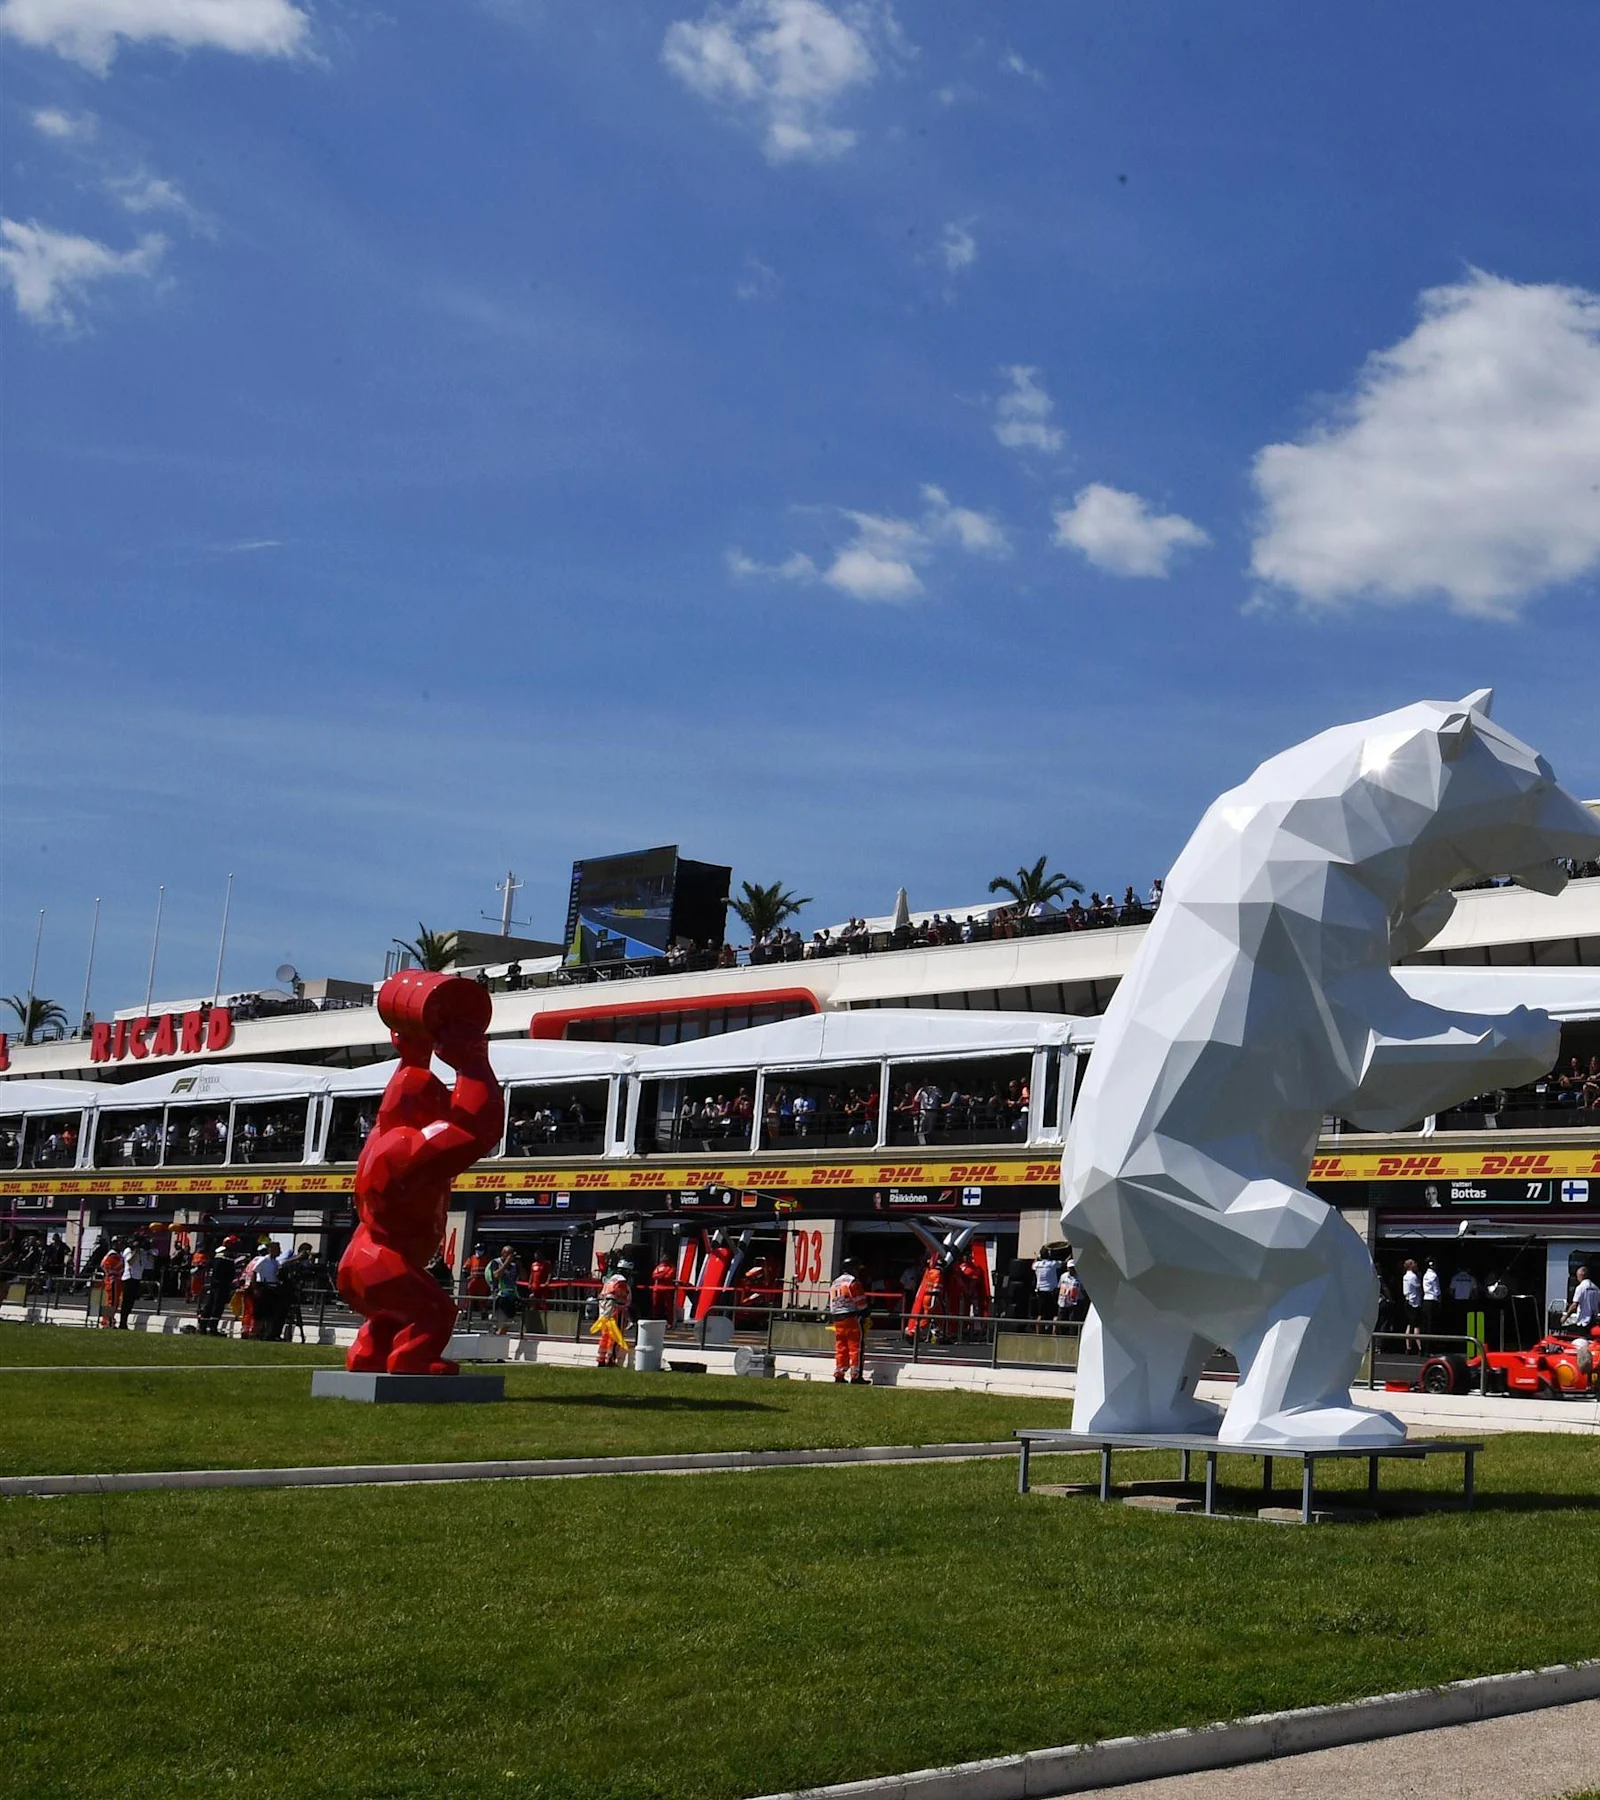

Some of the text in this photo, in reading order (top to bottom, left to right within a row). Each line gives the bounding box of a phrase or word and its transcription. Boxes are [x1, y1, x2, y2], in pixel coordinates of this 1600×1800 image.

[90, 1008, 233, 1063] RICARD
[1310, 1159, 1345, 1177] HL
[1376, 1157, 1450, 1176] DHL
[1480, 1155, 1555, 1175] DHL
[574, 1174, 612, 1187] DHL
[628, 1172, 666, 1186] DHL
[685, 1171, 726, 1186] DHL
[747, 1170, 789, 1185] DHL
[810, 1169, 854, 1184] DHL
[878, 1167, 925, 1183] DHL
[949, 1165, 1000, 1182] DHL
[1024, 1165, 1060, 1181] DH
[189, 1180, 212, 1191] DHL
[224, 1179, 249, 1191] DHL
[261, 1179, 287, 1191] DHL
[301, 1178, 328, 1190] DHL
[474, 1175, 507, 1188] DHL
[523, 1174, 556, 1188] DHL
[1451, 1182, 1543, 1199] Bottas 77
[796, 1230, 822, 1283] 03
